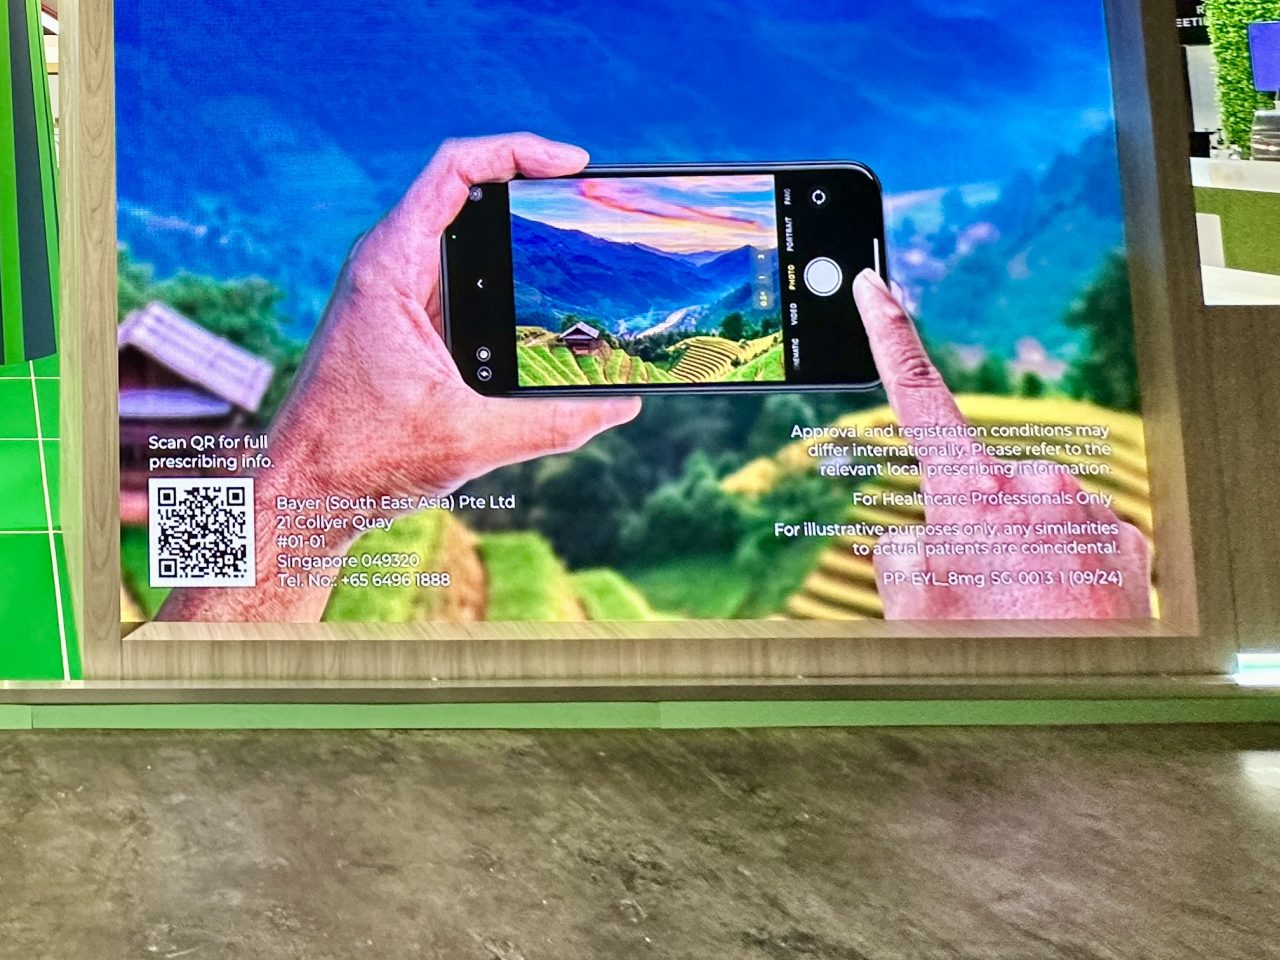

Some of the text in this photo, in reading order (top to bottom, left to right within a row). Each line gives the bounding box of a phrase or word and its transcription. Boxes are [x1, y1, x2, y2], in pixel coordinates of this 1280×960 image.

[785, 217, 794, 252] PORTRAIT
[787, 264, 796, 290] PHOTO
[789, 303, 798, 326] VIDEO
[791, 423, 1110, 440] Approval and registration conditions may
[148, 434, 268, 451] Scan QR for full
[808, 443, 848, 457] differ
[972, 444, 1021, 456] Please
[1025, 443, 1062, 456] refer
[1065, 444, 1081, 456] to
[1084, 442, 1111, 456] the
[149, 454, 275, 471] prescribing info.
[820, 462, 1114, 478] relevant local prescribing information.
[276, 495, 516, 512] Bayer (South East Asia) Pte Ltd
[852, 492, 878, 506] For
[882, 491, 967, 506] Healthcare
[971, 492, 1073, 506] Professionals
[276, 515, 394, 531] 21 Collyer Quay
[774, 522, 800, 537] For
[803, 521, 884, 536] illustrative
[888, 523, 960, 540] purposes
[1003, 523, 1031, 538] any
[1035, 520, 1119, 536] similarities
[276, 535, 326, 548] #01-01
[852, 540, 1121, 558] to actual patients are coincidental.
[277, 554, 420, 570] Singapore 049320
[278, 573, 304, 587] Tel.
[341, 573, 369, 587] +65
[371, 573, 412, 587] 6496
[415, 573, 451, 587] 1888
[1069, 569, 1123, 588] (09/24)
